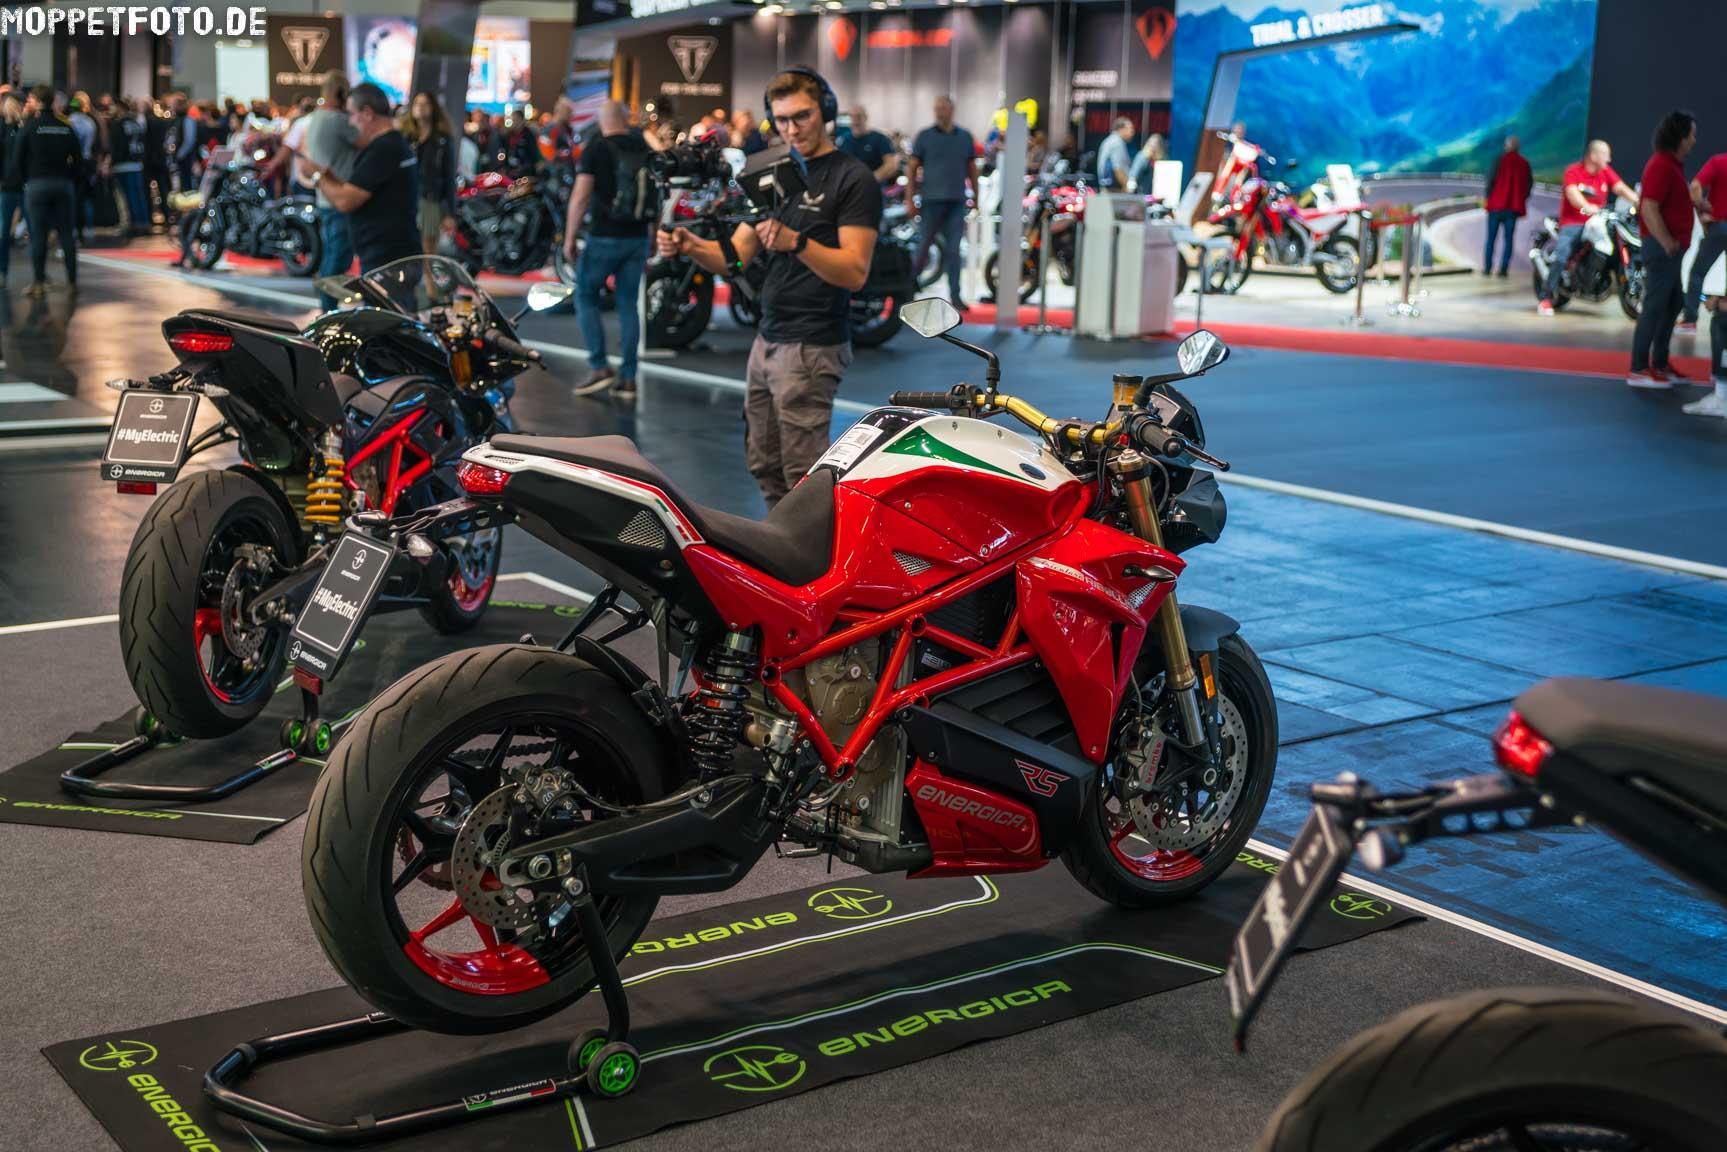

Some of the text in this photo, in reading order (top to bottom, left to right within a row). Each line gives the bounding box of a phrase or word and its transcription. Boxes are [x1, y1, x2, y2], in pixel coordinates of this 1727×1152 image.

[116, 427, 180, 444] #MyElectric
[312, 587, 359, 620] #MyElectric
[1014, 758, 1072, 798] RS
[1144, 741, 1163, 785] brembo
